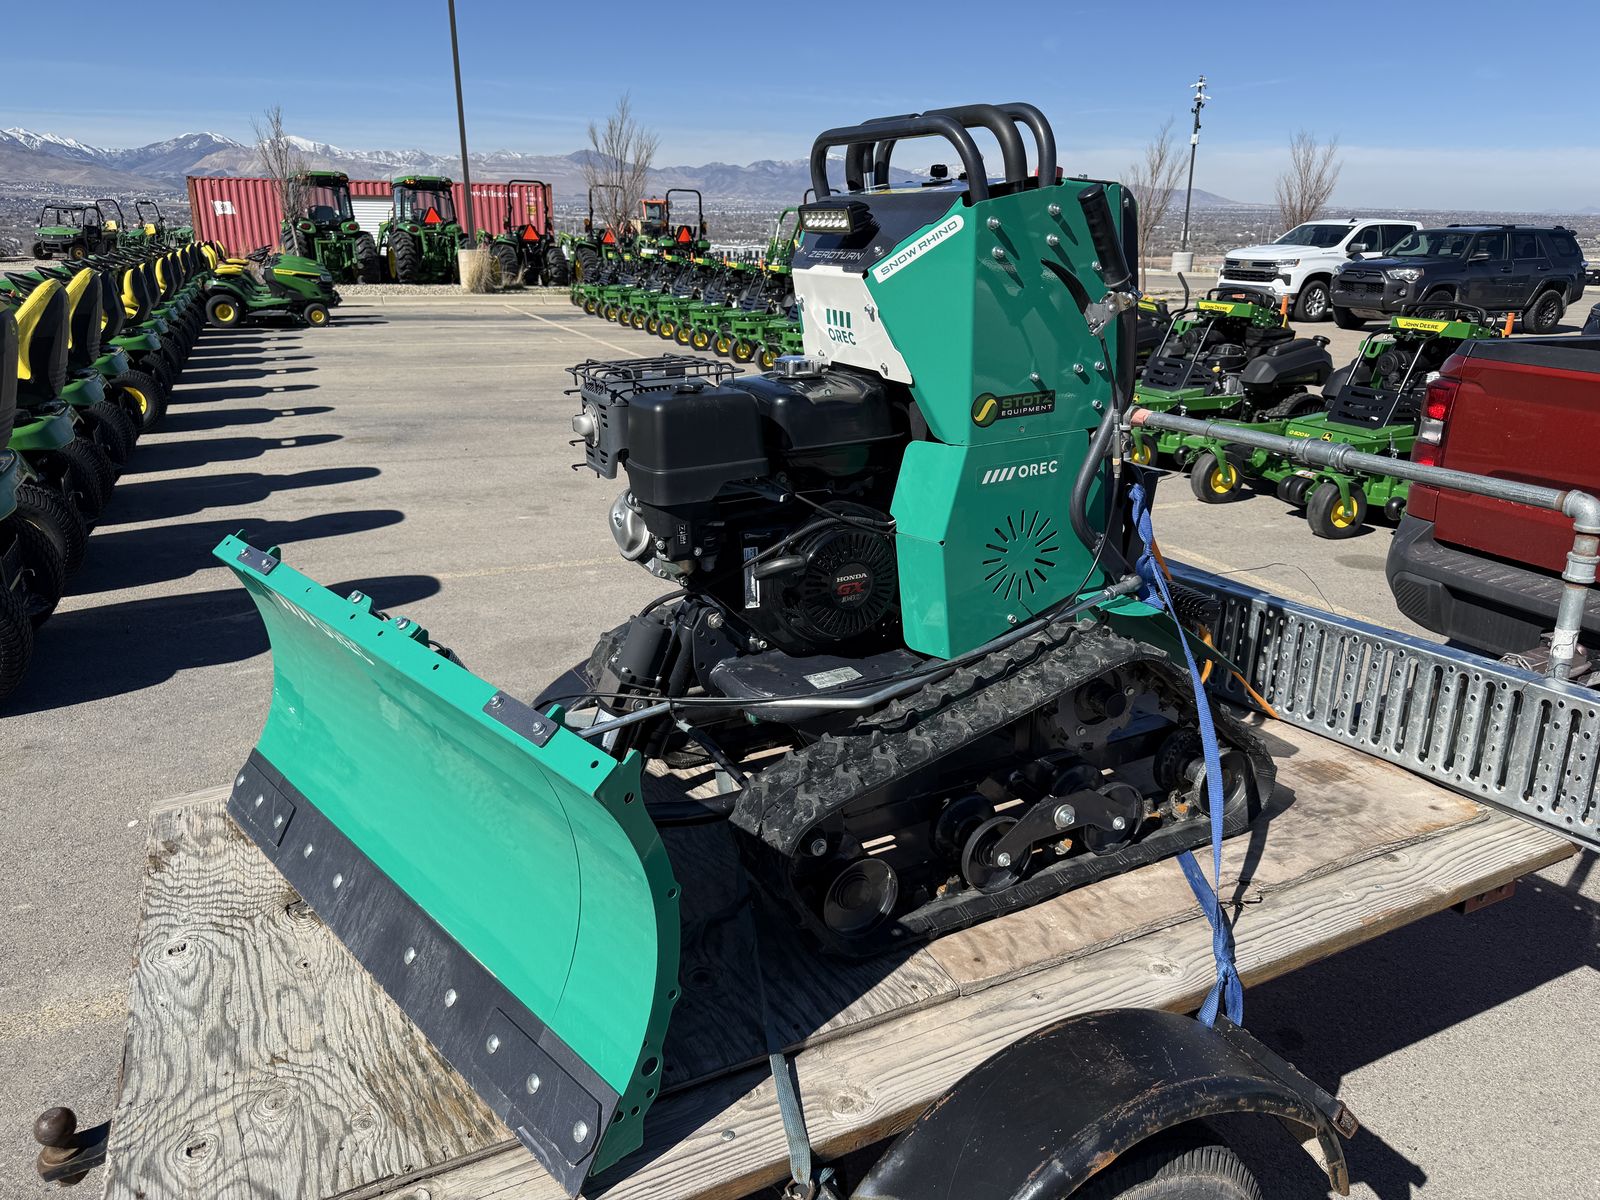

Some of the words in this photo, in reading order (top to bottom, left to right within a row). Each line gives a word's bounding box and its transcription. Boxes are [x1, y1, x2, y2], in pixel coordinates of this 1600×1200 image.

[808, 249, 865, 260] ZEROTURN
[880, 247, 917, 276] SNOW
[918, 220, 958, 251] RHINO
[1420, 322, 1439, 330] DEERE
[828, 327, 856, 346] OREC
[1001, 392, 1053, 409] STOTZ
[1001, 404, 1053, 416] EQUIPMENT
[1018, 460, 1058, 478] OREC
[836, 572, 868, 583] HONDA
[837, 582, 865, 597] GX
